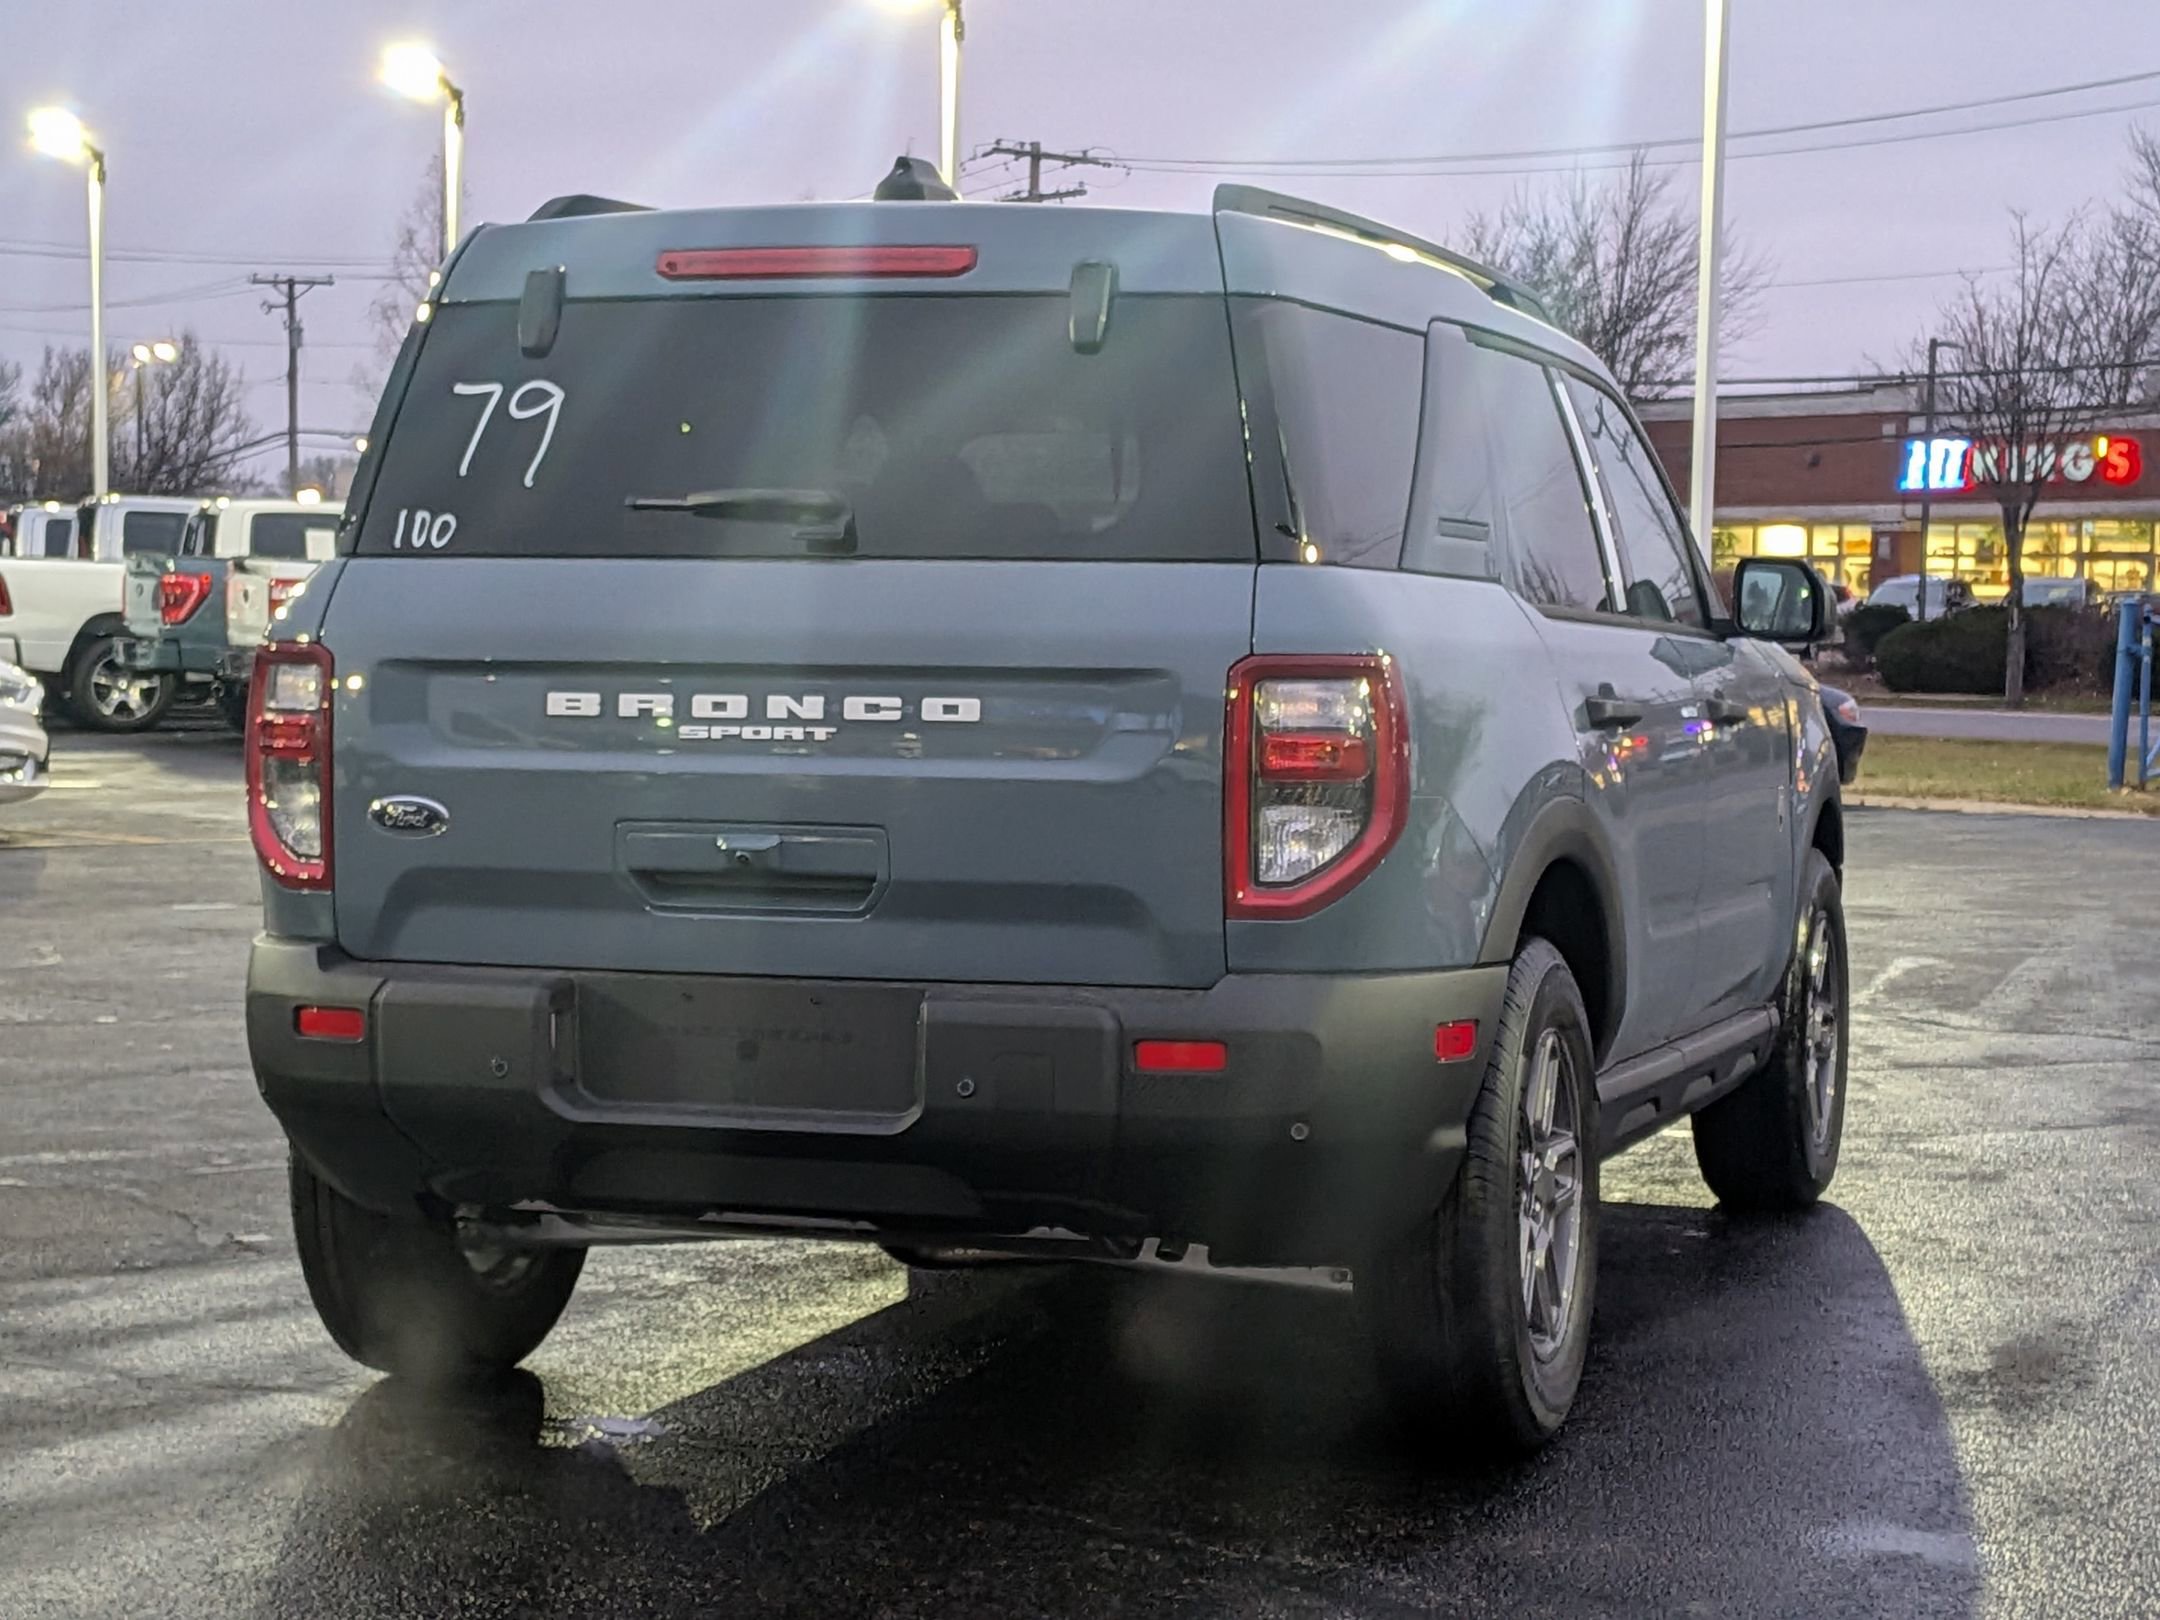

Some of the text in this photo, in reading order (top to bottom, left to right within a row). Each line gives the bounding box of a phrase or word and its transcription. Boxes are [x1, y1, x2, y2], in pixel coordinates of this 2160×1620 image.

[453, 380, 565, 488] 79
[394, 508, 457, 549] 100
[546, 692, 981, 722] BRONCO
[678, 725, 837, 741] SPORT
